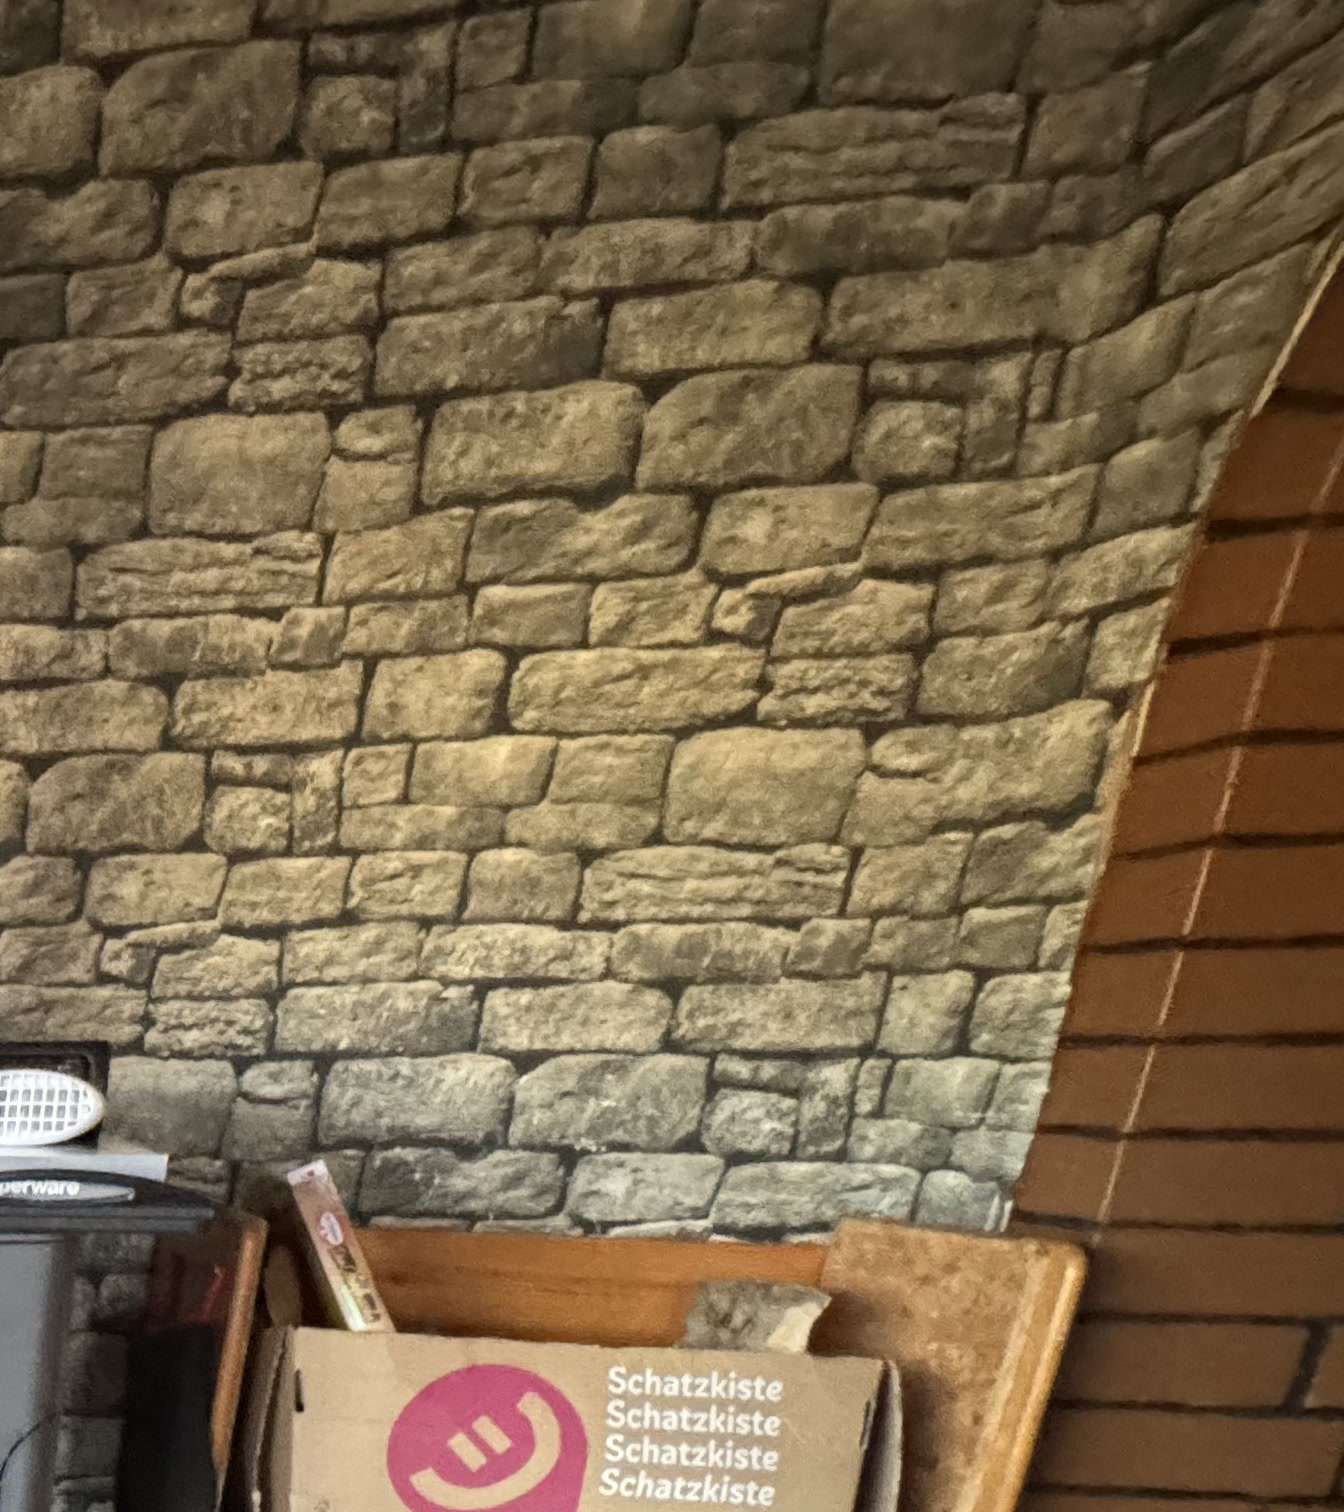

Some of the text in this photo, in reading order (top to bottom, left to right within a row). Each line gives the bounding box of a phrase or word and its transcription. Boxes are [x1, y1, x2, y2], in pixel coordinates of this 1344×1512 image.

[607, 1365, 784, 1402] Schatzkiste
[606, 1399, 782, 1437] Schatzkiste
[604, 1433, 779, 1472] Schatzkiste
[598, 1468, 776, 1507] Schatzkiste
